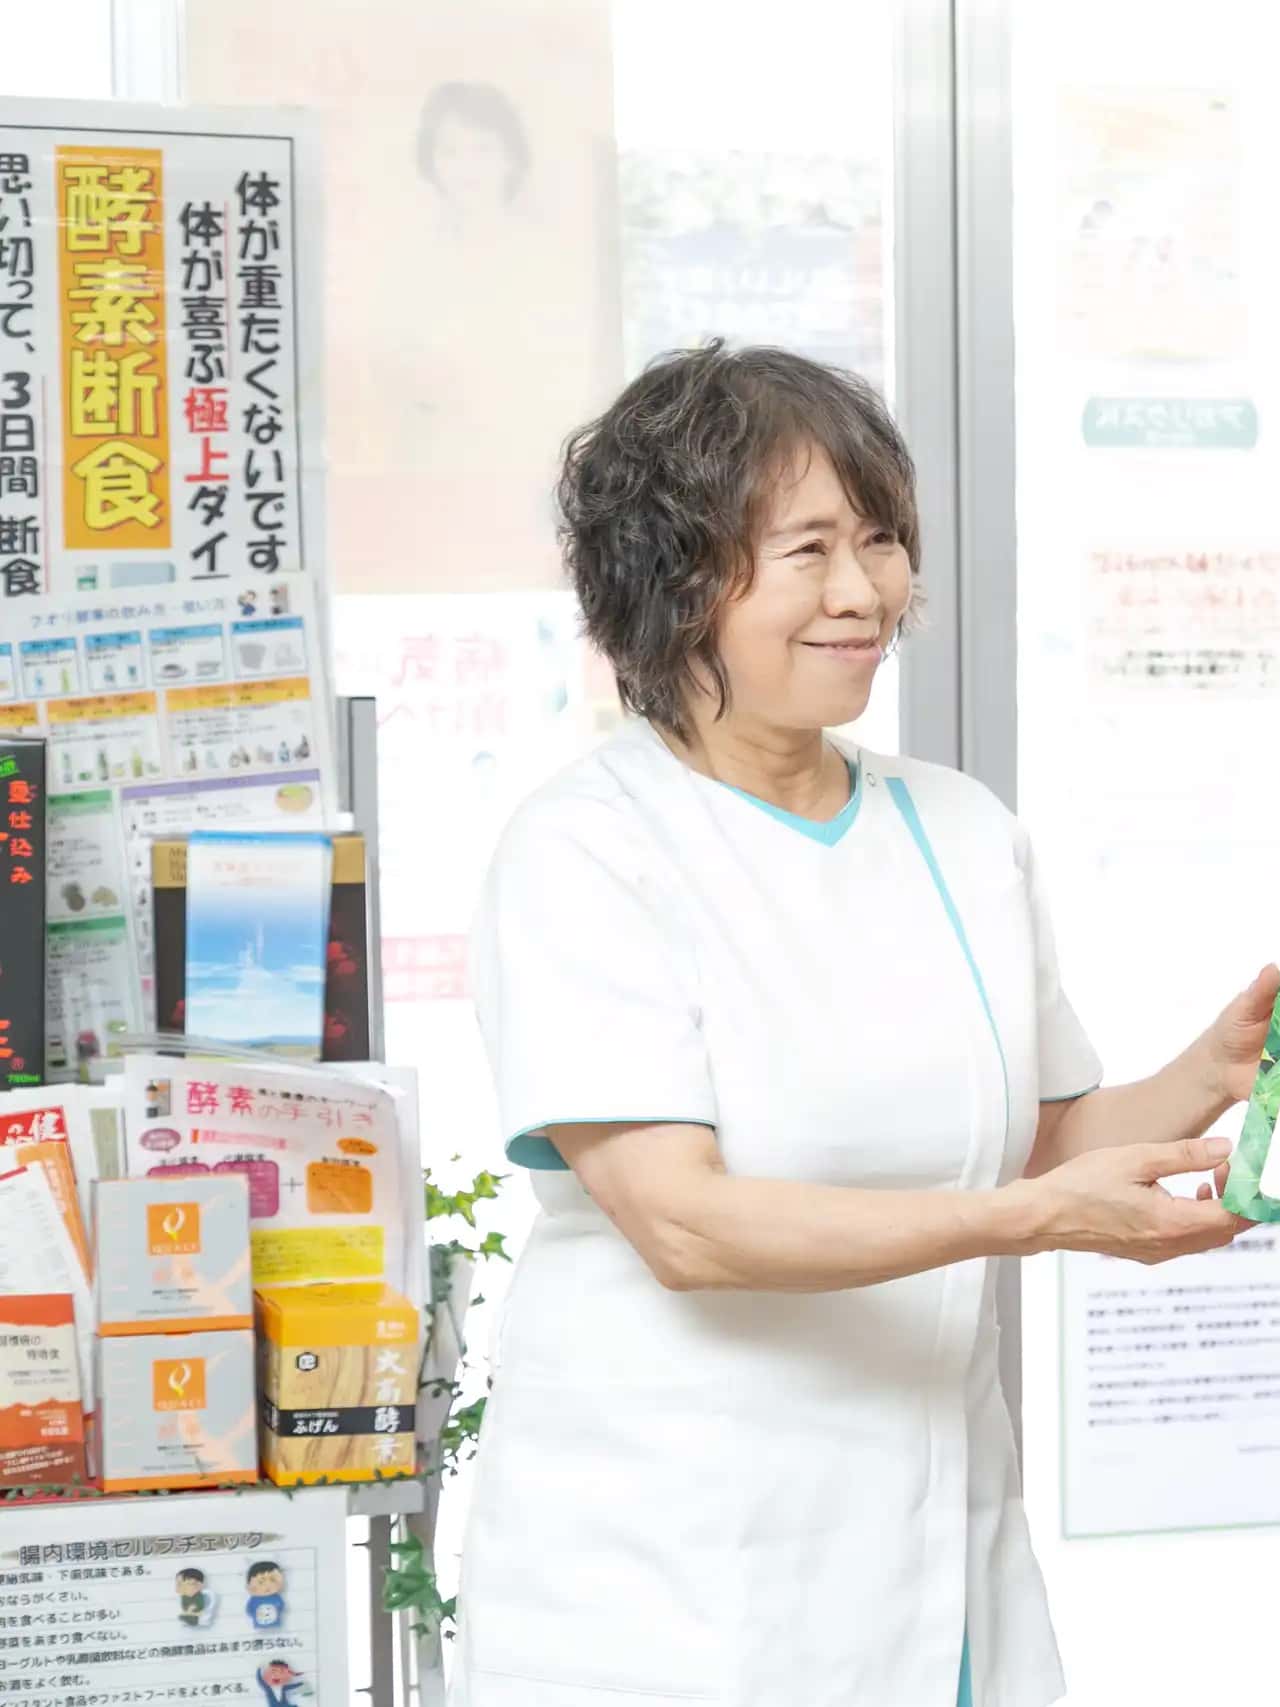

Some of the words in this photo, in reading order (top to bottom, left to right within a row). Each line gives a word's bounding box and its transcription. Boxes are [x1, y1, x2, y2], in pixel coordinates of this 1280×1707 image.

[62, 165, 164, 531] 酵素断食
[178, 201, 230, 581] 体が喜ぶ極上ダイ
[235, 170, 286, 573] 体が重たくないです
[19, 1532, 265, 1566] 腸内環境セルフチェック
